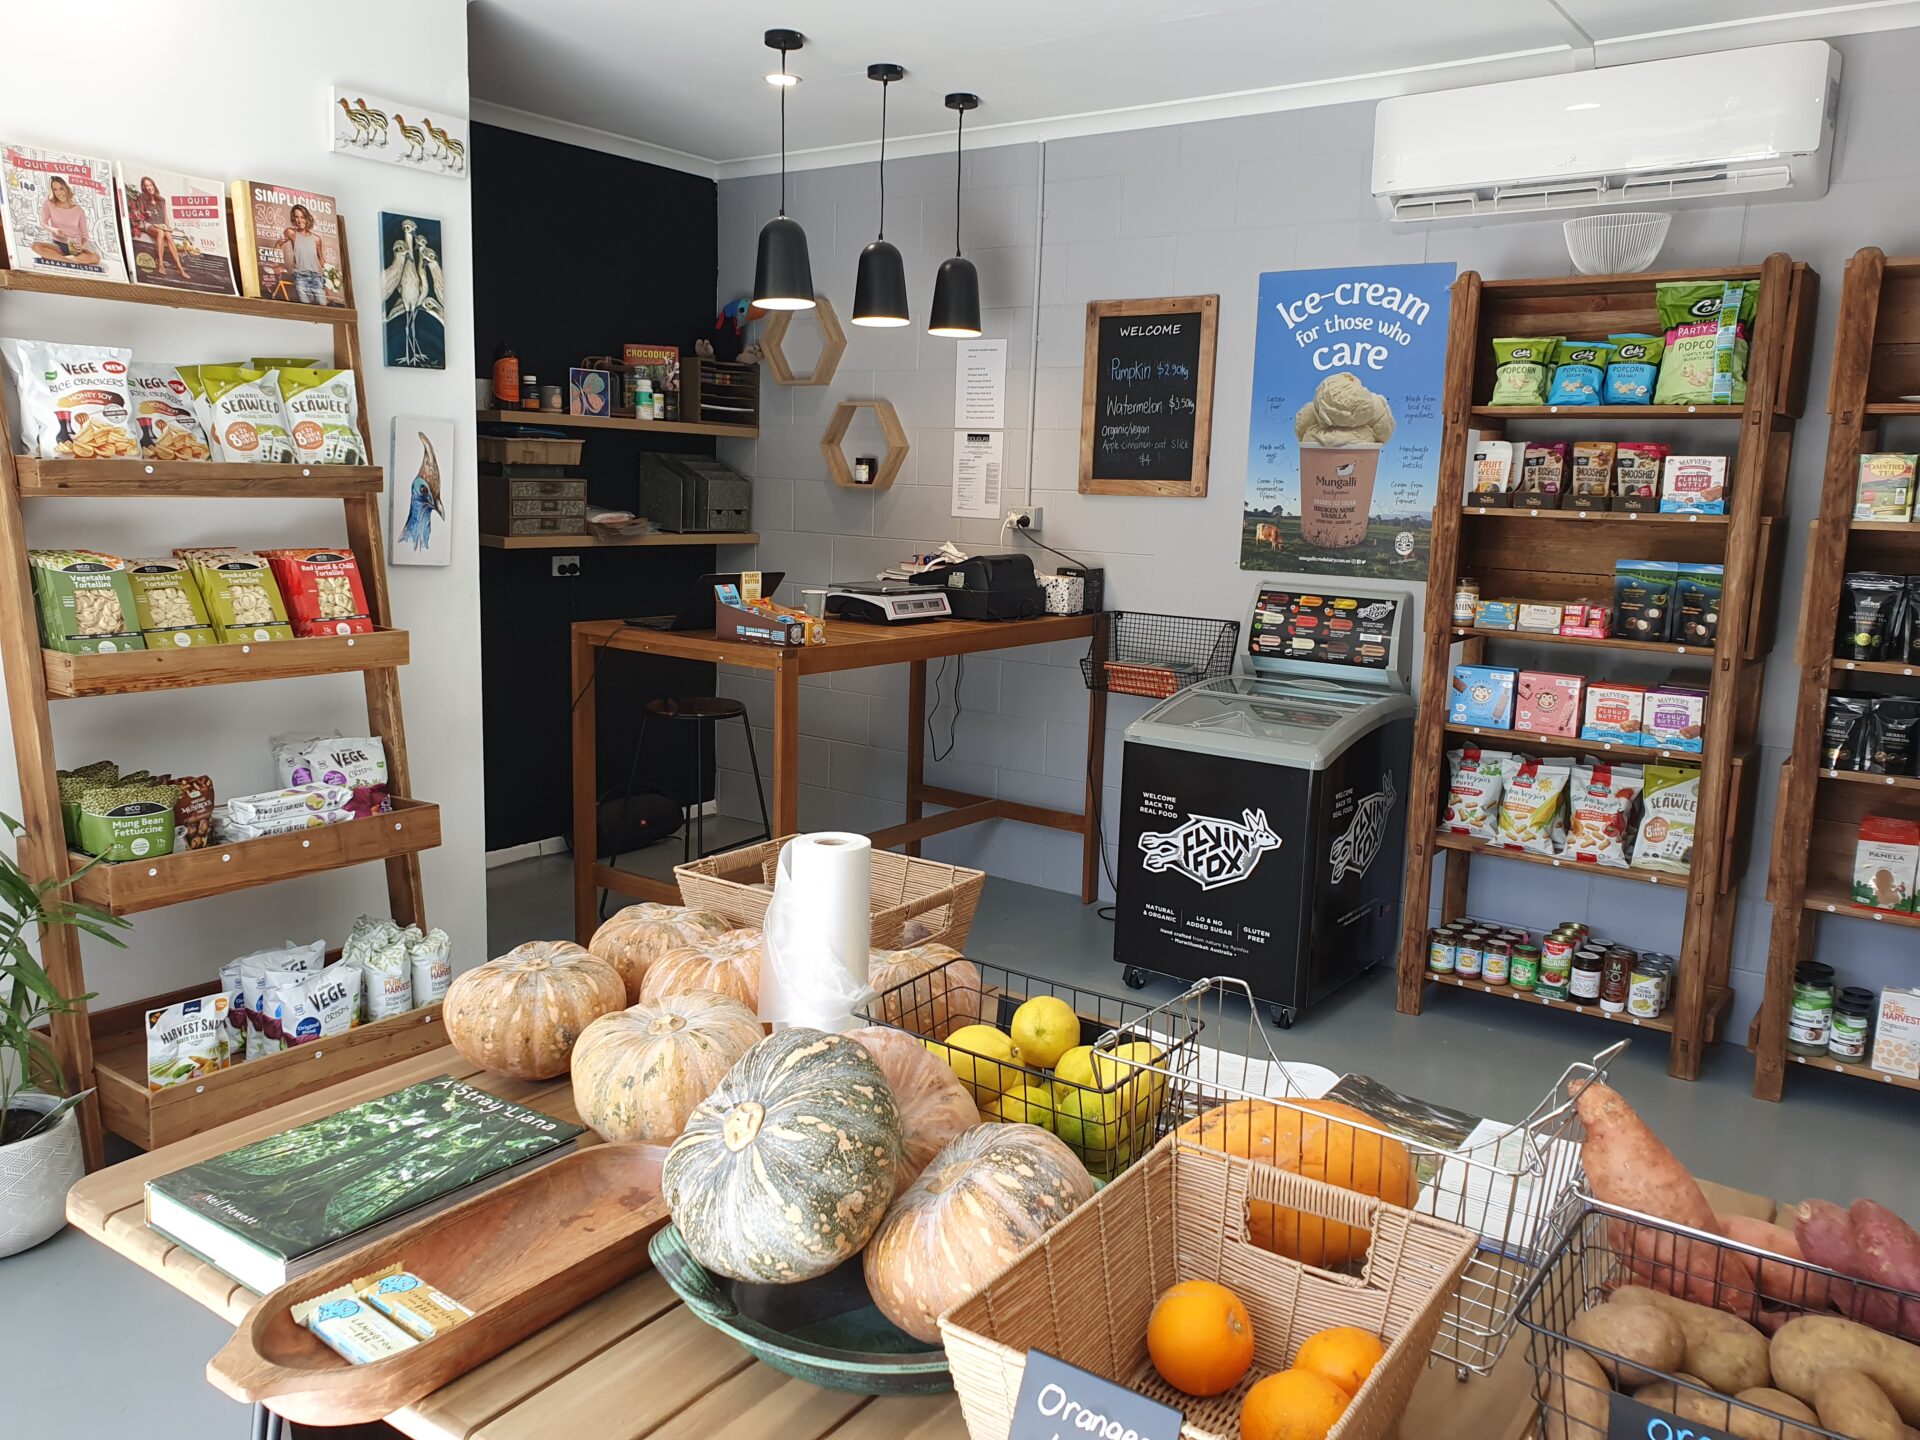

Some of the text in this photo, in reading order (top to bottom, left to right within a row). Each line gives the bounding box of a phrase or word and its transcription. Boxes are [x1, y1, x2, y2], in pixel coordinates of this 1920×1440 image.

[24, 160, 49, 170] QUIT
[53, 164, 88, 175] SUGAR
[188, 197, 210, 205] QUIT
[254, 188, 332, 214] SIMPLICIOUS
[180, 210, 211, 218] SUGAR
[254, 204, 286, 226] 306
[256, 230, 285, 240] RECIPES
[258, 248, 284, 258] CAKES
[40, 259, 100, 272] SARAH WILSON
[1276, 282, 1430, 330] Ice-cream
[1692, 298, 1722, 316] Cob
[1120, 324, 1182, 337] WELCOME
[1296, 314, 1412, 348] for those who
[1678, 325, 1707, 336] PARTY
[1620, 344, 1646, 358] Cobs
[1678, 340, 1714, 352] POPCO
[1312, 342, 1388, 371] care
[1512, 349, 1532, 359] Cobs
[1572, 350, 1596, 360] Cobs
[60, 362, 98, 376] VEGE
[106, 363, 124, 373] NEW
[1112, 358, 1152, 388] Pumpkin
[1502, 366, 1536, 374] POPCORN
[49, 378, 126, 392] RICE CRACKERS
[98, 392, 113, 400] SOY
[222, 400, 280, 414] SEAWEED
[292, 400, 350, 414] SEAWEED
[1106, 394, 1162, 416] Watermelon
[229, 434, 243, 448] 8
[295, 432, 308, 446] 8
[1138, 452, 1152, 466] $4
[1478, 460, 1504, 468] FRUIT
[1576, 467, 1609, 478] SMOOSHED
[1621, 469, 1656, 479] SMOOSHED
[1316, 476, 1357, 490] Mungalli
[301, 564, 314, 572] Red
[314, 564, 332, 572] Lentil
[338, 562, 355, 570] Chilli
[69, 575, 112, 583] Vegetable
[218, 572, 248, 580] Smoked
[1598, 712, 1627, 720] BUTTER
[331, 750, 369, 768] VEGE
[1466, 773, 1491, 784] Veggies
[1142, 792, 1177, 803] WELCOME
[1335, 787, 1354, 800] WELCOME
[1522, 788, 1546, 800] Veggies
[1144, 800, 1163, 809] BACK
[1336, 799, 1346, 809] BACK
[1650, 798, 1696, 812] SEAWEE
[1140, 806, 1178, 819] REAL FOOD
[1332, 806, 1354, 819] REAL FOOD
[112, 818, 164, 830] Mung Bean
[114, 826, 163, 838] Fettuccine
[1646, 827, 1652, 838] 8
[1357, 824, 1380, 865] FOX
[1868, 852, 1904, 860] PANELA
[1192, 848, 1244, 878] FOX
[1146, 904, 1174, 916] NATURAL
[1148, 911, 1177, 923] ORGANIC
[1212, 919, 1223, 927] NO
[1186, 920, 1233, 936] ADDED SUGAR
[1243, 926, 1270, 938] GLUTEN
[1174, 930, 1192, 940] crafted
[1206, 940, 1222, 948] nature
[1247, 934, 1265, 944] FREE
[1210, 946, 1233, 956] Australia
[308, 982, 348, 1012] VEGE
[324, 1006, 350, 1024] CRISPS
[1883, 1004, 1906, 1014] PURE
[1882, 1012, 1920, 1024] HARVEST
[297, 1020, 321, 1032] Original
[160, 1021, 200, 1045] HARVEST
[434, 1080, 558, 1132] A Stray Liana
[202, 1194, 260, 1225] Neil Hewett
[1038, 1383, 1150, 1440] Orange
